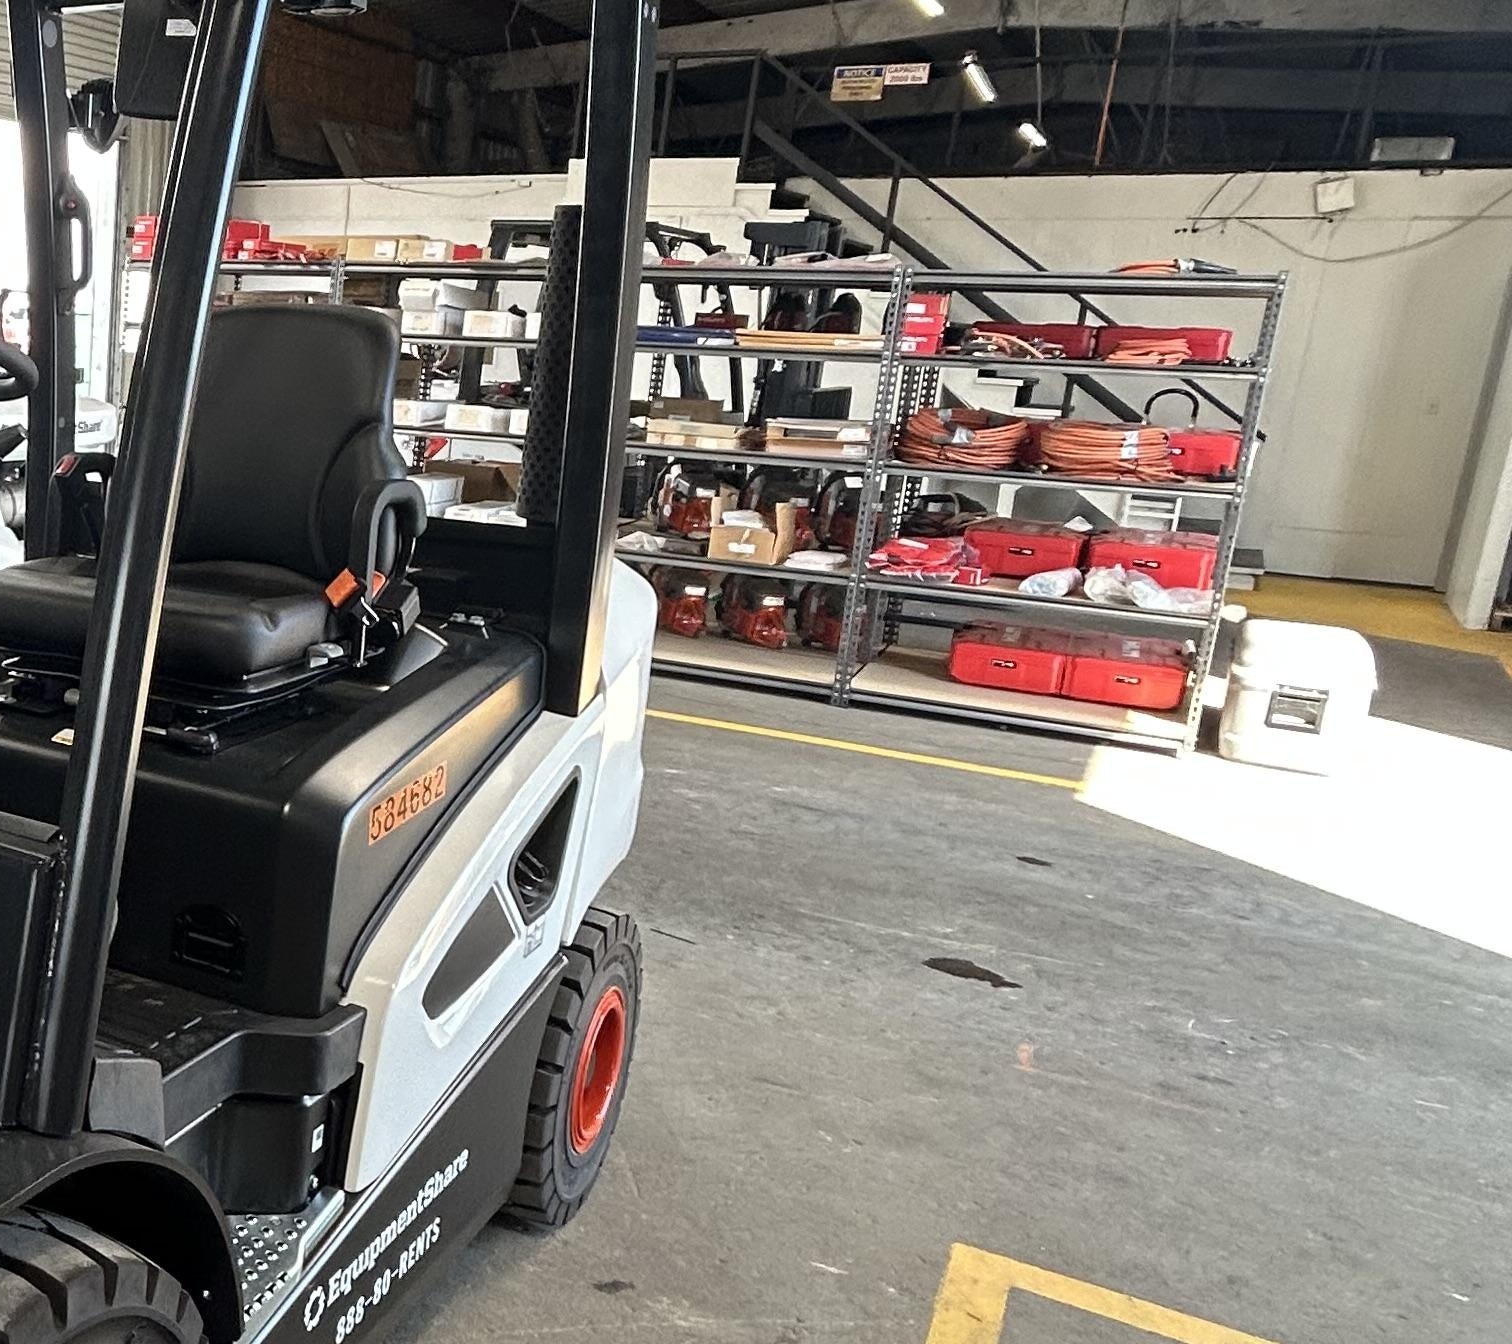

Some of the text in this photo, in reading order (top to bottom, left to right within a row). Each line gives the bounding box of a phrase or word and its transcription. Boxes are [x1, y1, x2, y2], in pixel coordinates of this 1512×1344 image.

[370, 765, 445, 840] 584682
[327, 1148, 469, 1307] EquipmentShare
[335, 1216, 441, 1344] 888-80-RENTS
